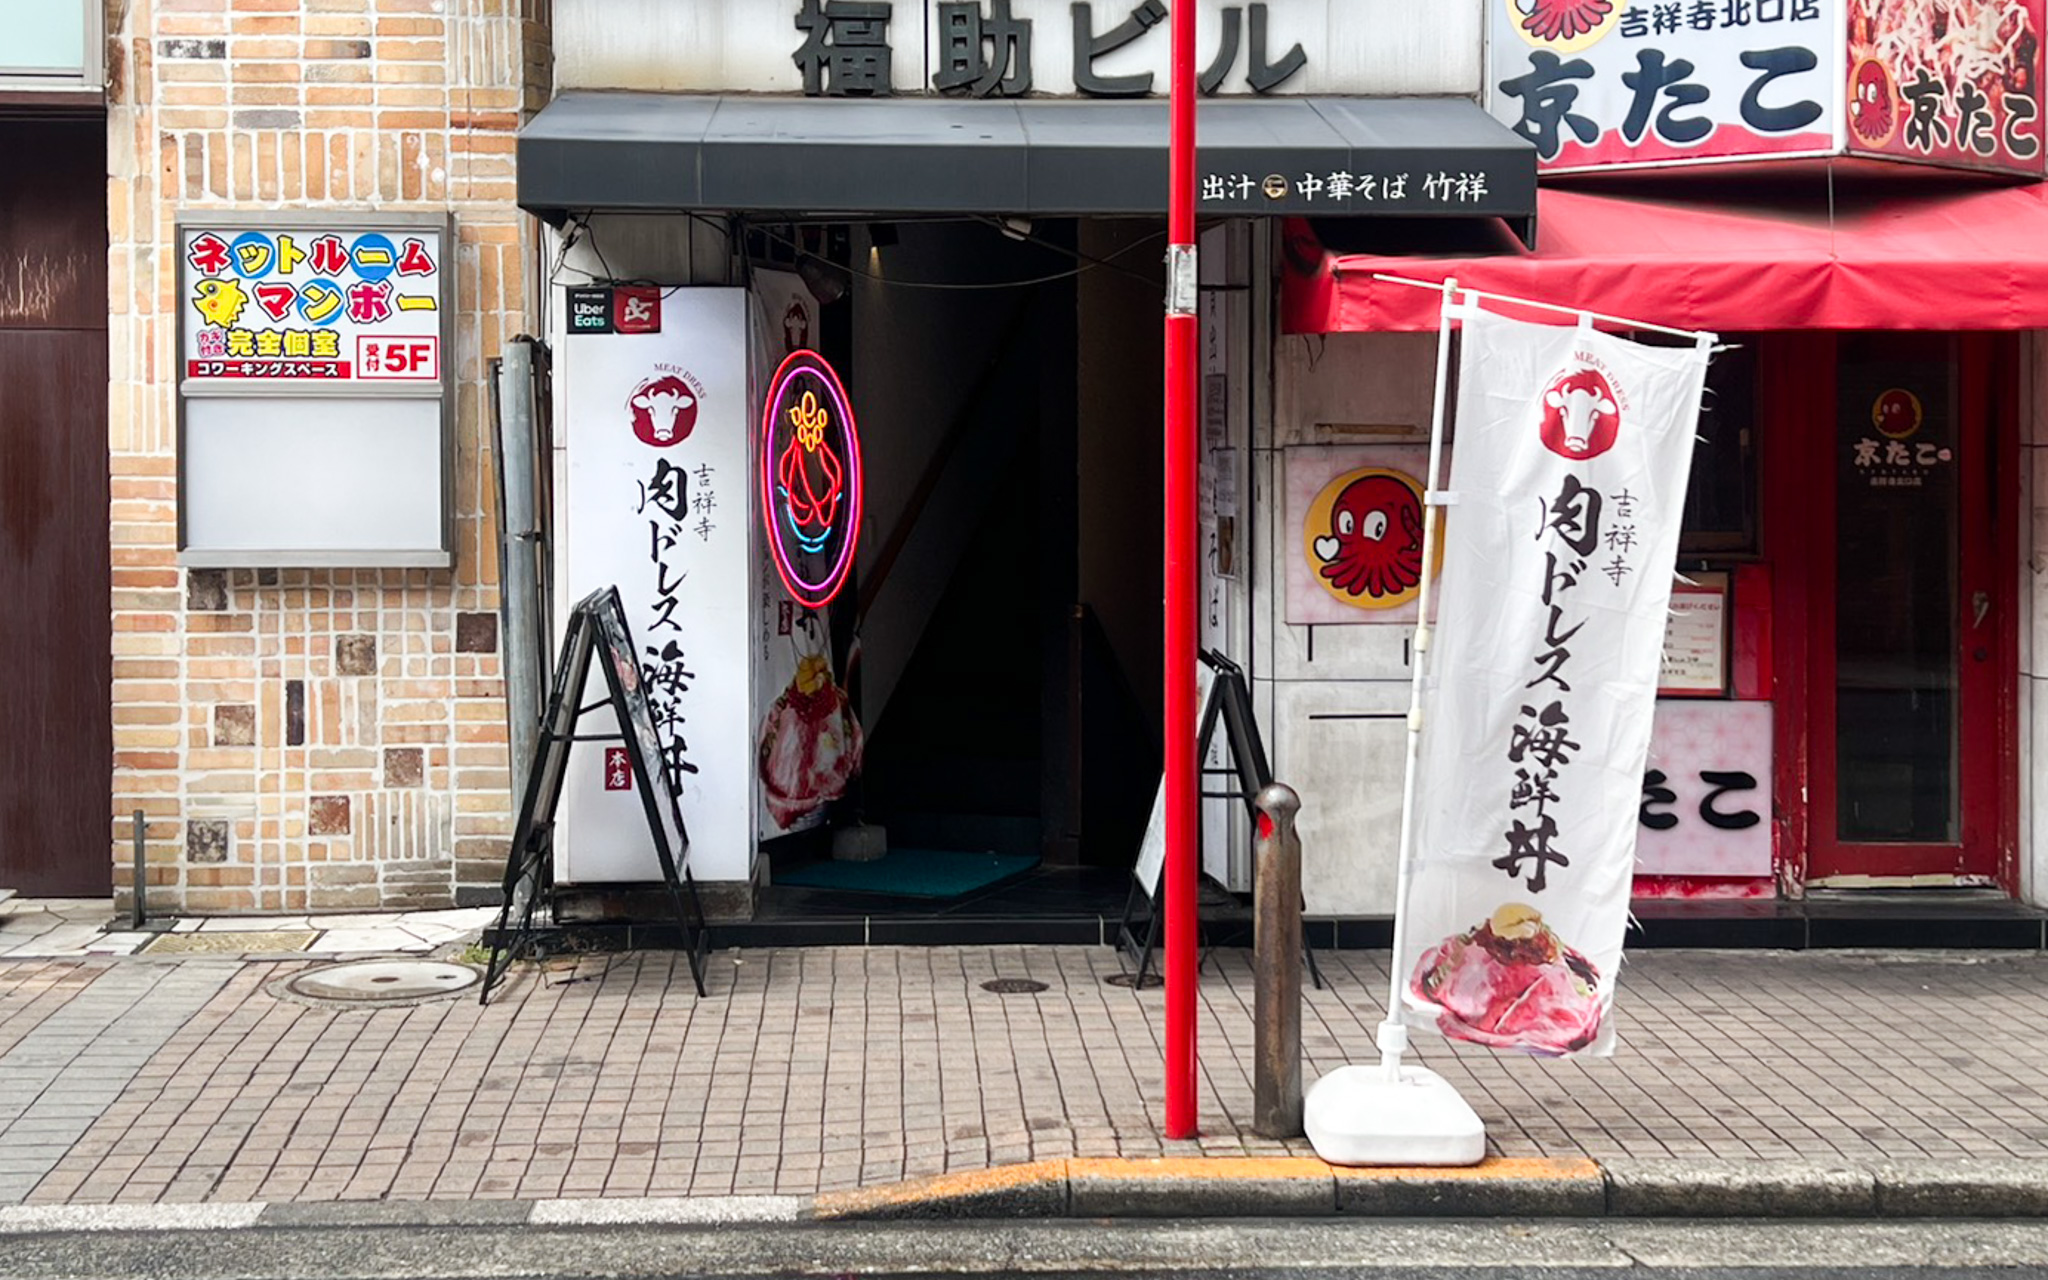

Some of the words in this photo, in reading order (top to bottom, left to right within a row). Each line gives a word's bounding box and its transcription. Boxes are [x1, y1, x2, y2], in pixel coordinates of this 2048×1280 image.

[1620, 0, 1820, 39] 吉祥寺北口店
[793, 0, 1308, 97] 福助ビル
[1500, 46, 1824, 160] 京たこ
[1902, 69, 2039, 159] 京たこ
[1202, 173, 1256, 200] 出汁
[1296, 171, 1410, 201] 中華そば
[1422, 171, 1489, 202] 竹祥
[189, 232, 437, 277] ネットルーム
[252, 280, 437, 323] マンボー
[574, 303, 605, 315] Uber
[574, 315, 605, 328] Eats
[226, 328, 340, 358] 完全個室
[385, 344, 431, 372] 5F
[1573, 350, 1607, 371] MEAT
[197, 362, 339, 377] コワーキングスペース
[653, 363, 683, 376] MEAT
[682, 371, 707, 400] DRESS
[1853, 438, 1938, 467] 京たこ
[692, 463, 717, 542] 吉祥寺
[1601, 488, 1639, 587] 吉祥寺
[608, 751, 628, 788] 本店
